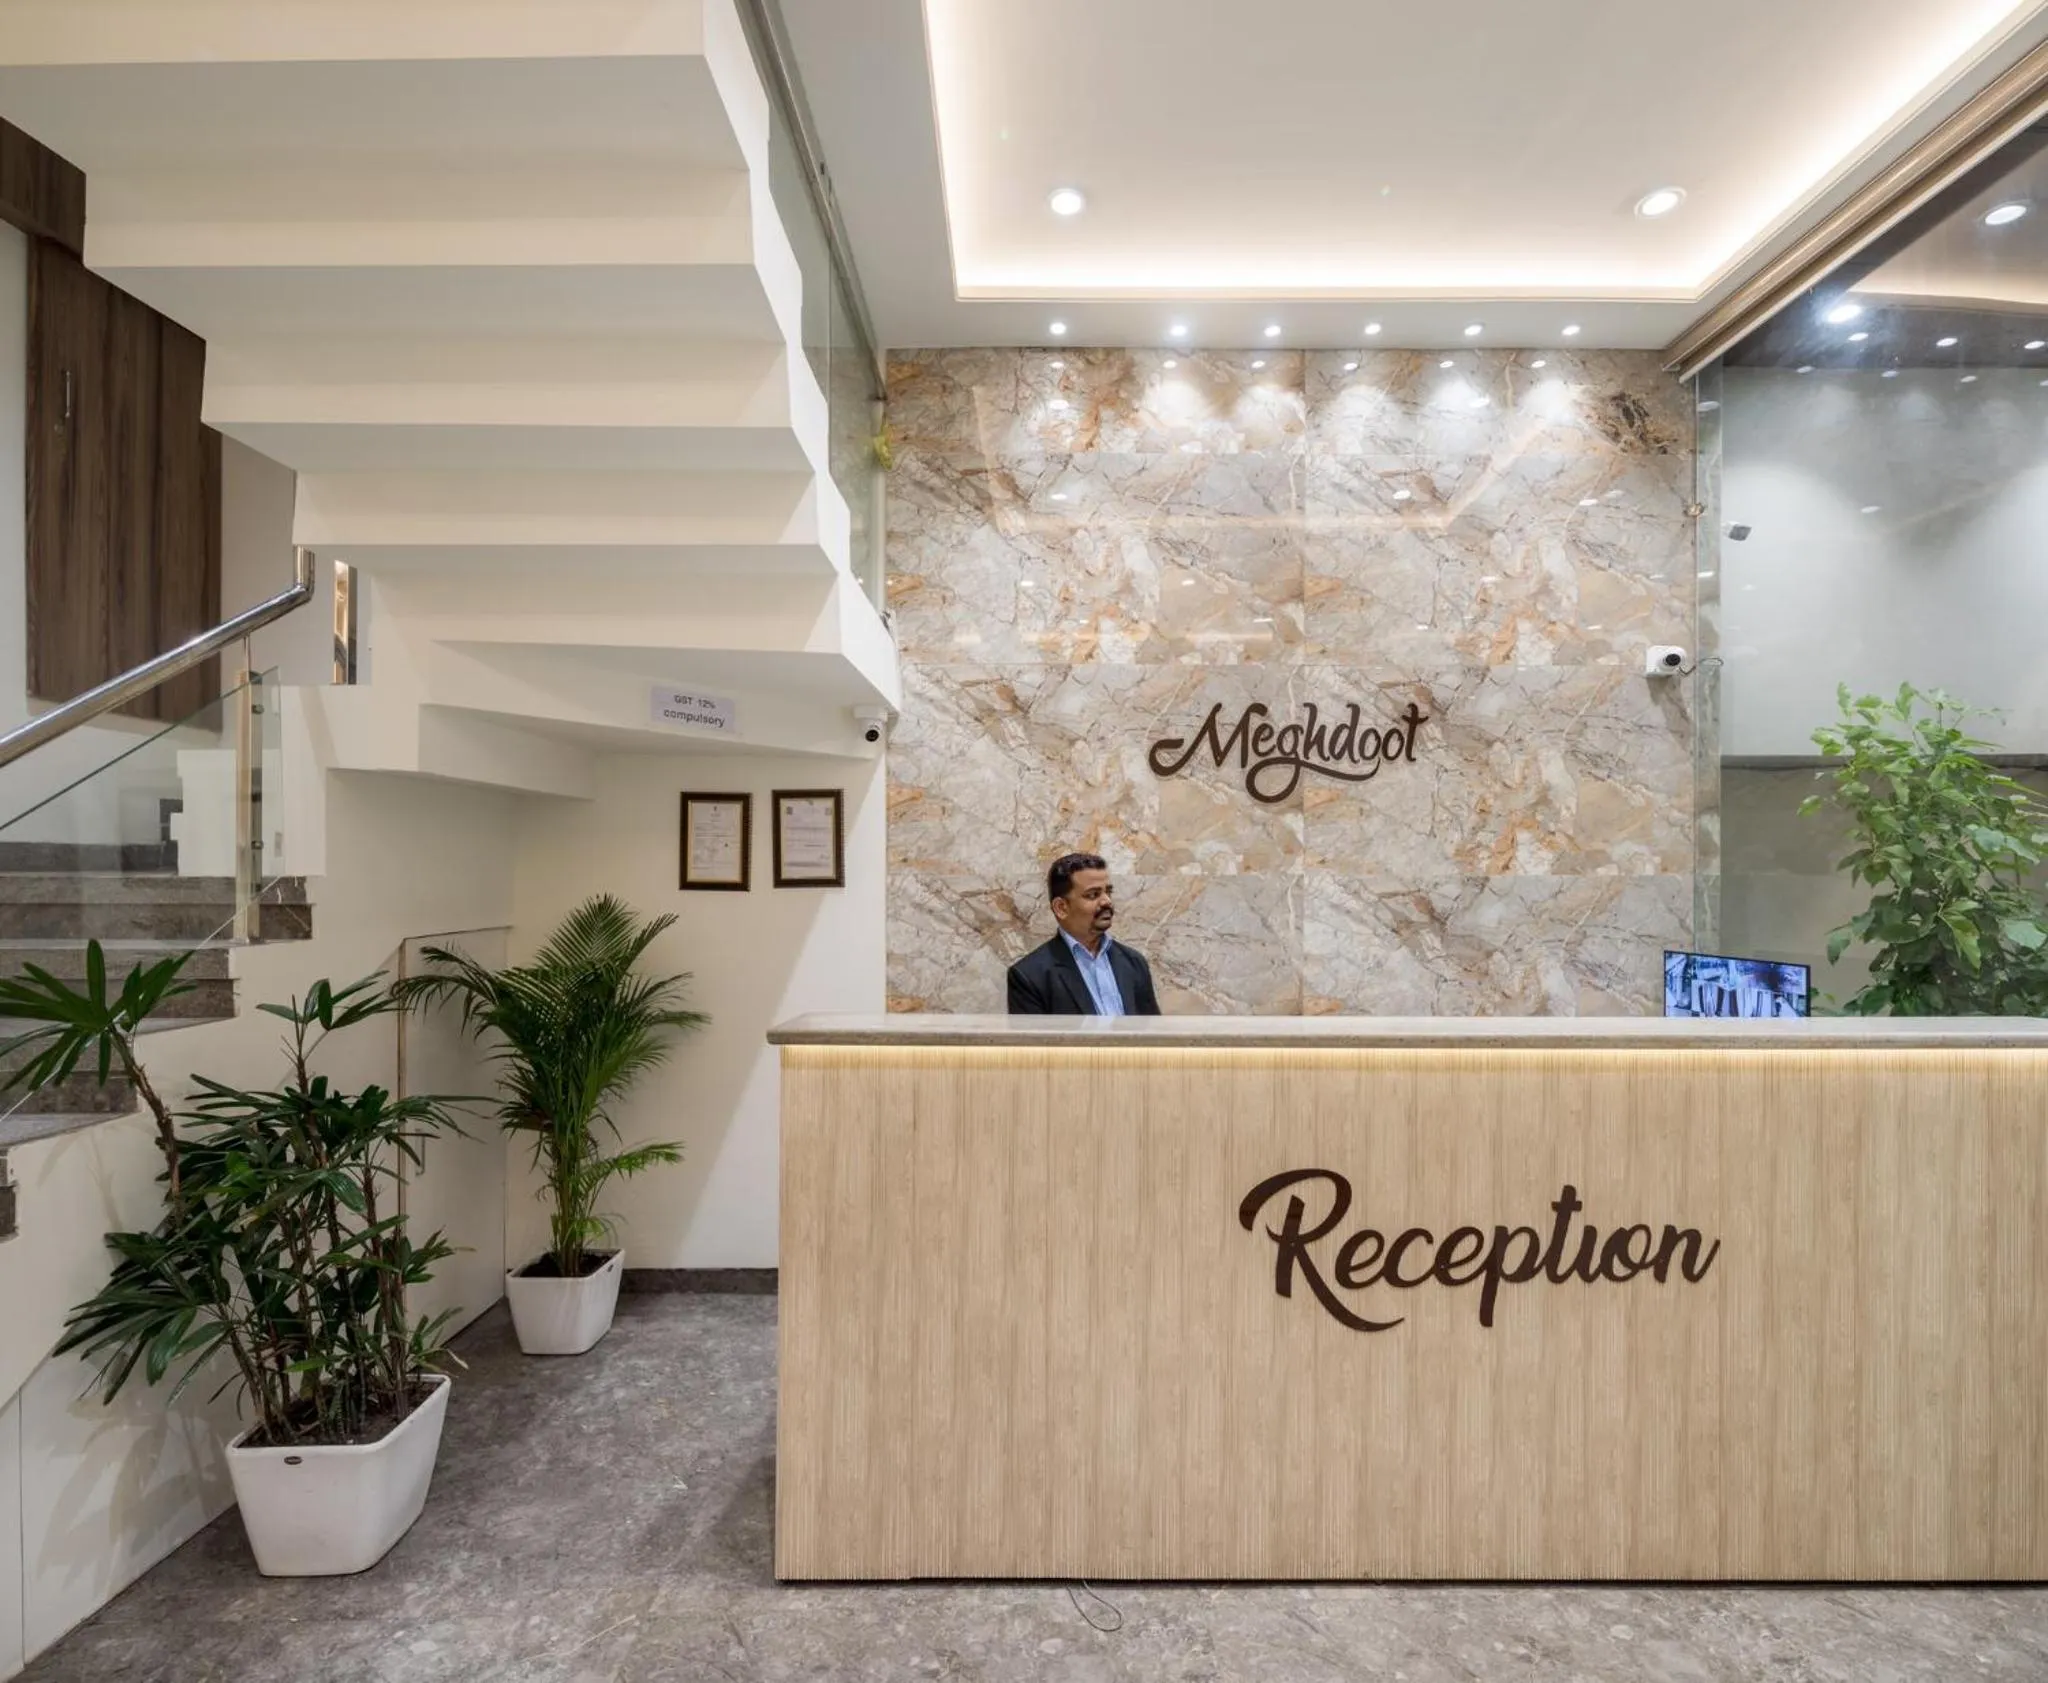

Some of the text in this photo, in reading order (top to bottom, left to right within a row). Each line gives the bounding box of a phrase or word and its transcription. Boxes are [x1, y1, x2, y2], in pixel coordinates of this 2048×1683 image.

[663, 709, 725, 728] compulsory
[1149, 702, 1429, 803] Meghdoot
[1238, 1168, 1721, 1333] Reception
